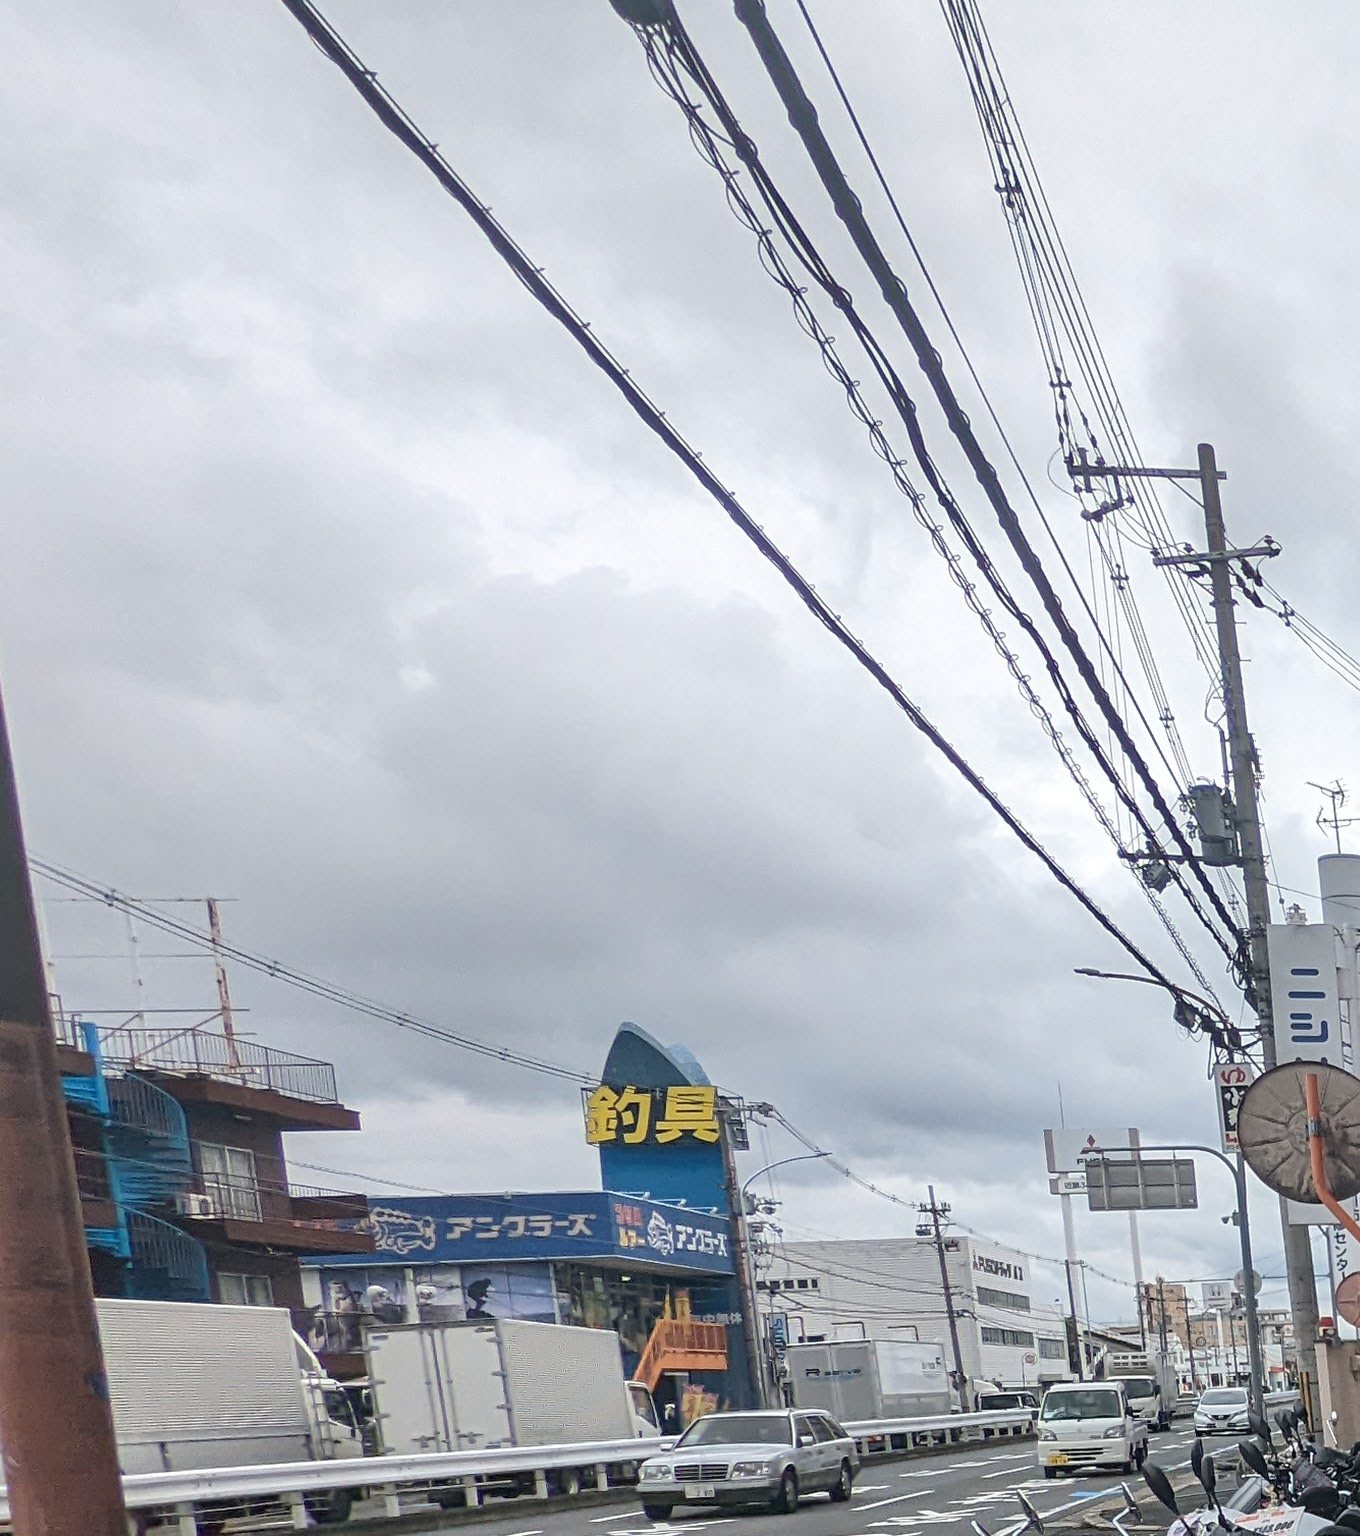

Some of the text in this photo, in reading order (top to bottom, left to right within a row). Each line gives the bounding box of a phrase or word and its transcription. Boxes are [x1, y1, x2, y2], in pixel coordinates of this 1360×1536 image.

[586, 1085, 721, 1144] 釣具
[446, 1214, 596, 1240] アングラーズ
